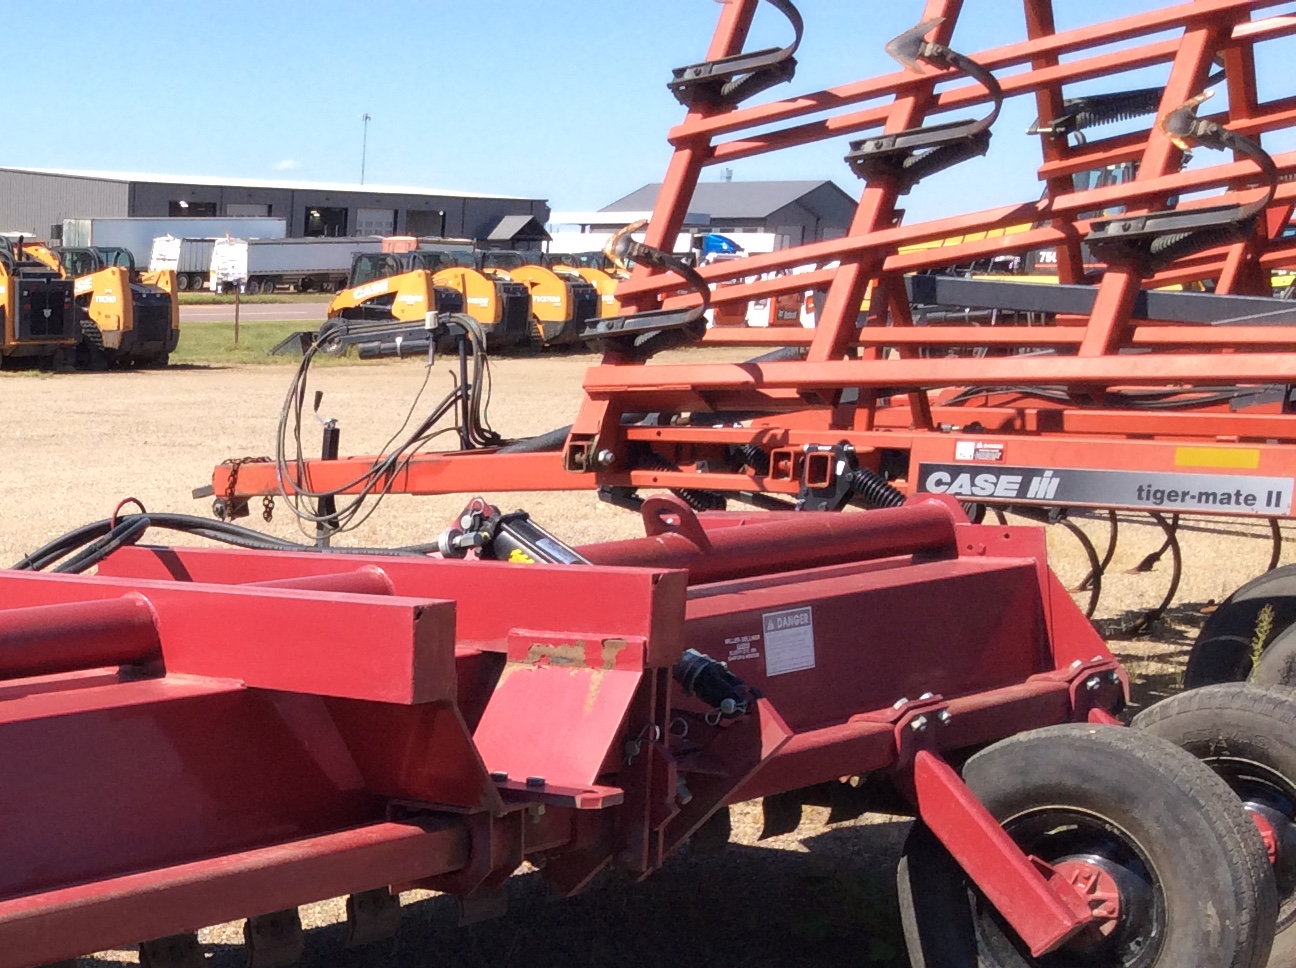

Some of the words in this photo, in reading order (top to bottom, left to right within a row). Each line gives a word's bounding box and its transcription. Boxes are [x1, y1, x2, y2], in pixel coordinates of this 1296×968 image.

[925, 471, 1023, 498] CASE
[1136, 484, 1258, 508] tiger-mate
[776, 613, 810, 629] DANGER
